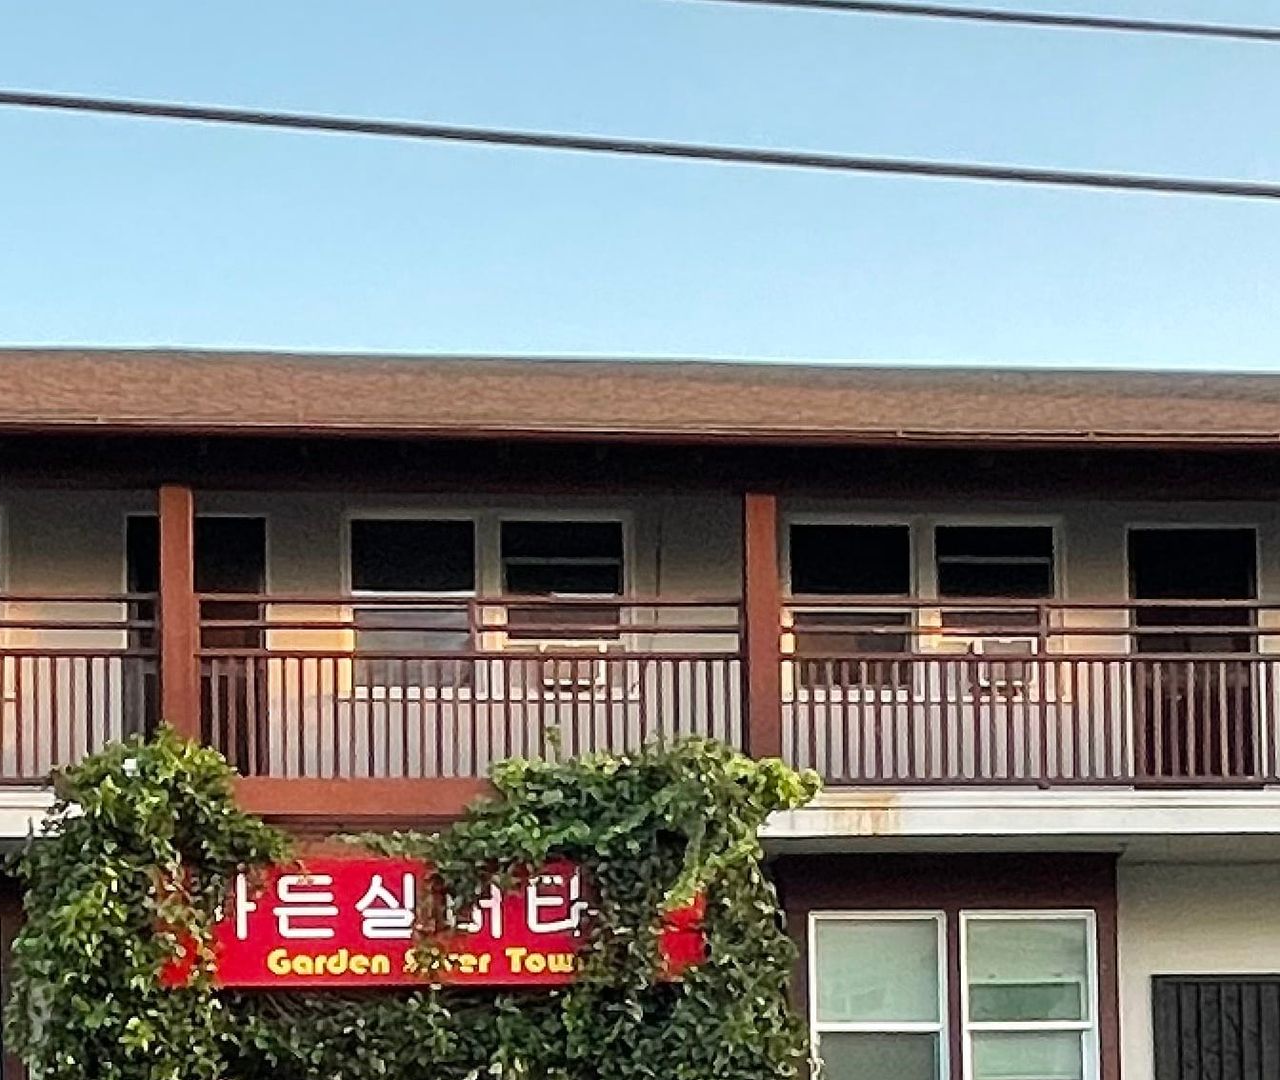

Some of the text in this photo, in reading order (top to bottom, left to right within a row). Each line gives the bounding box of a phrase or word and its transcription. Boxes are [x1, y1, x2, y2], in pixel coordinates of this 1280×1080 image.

[267, 947, 583, 975] Garden Sver Tow
